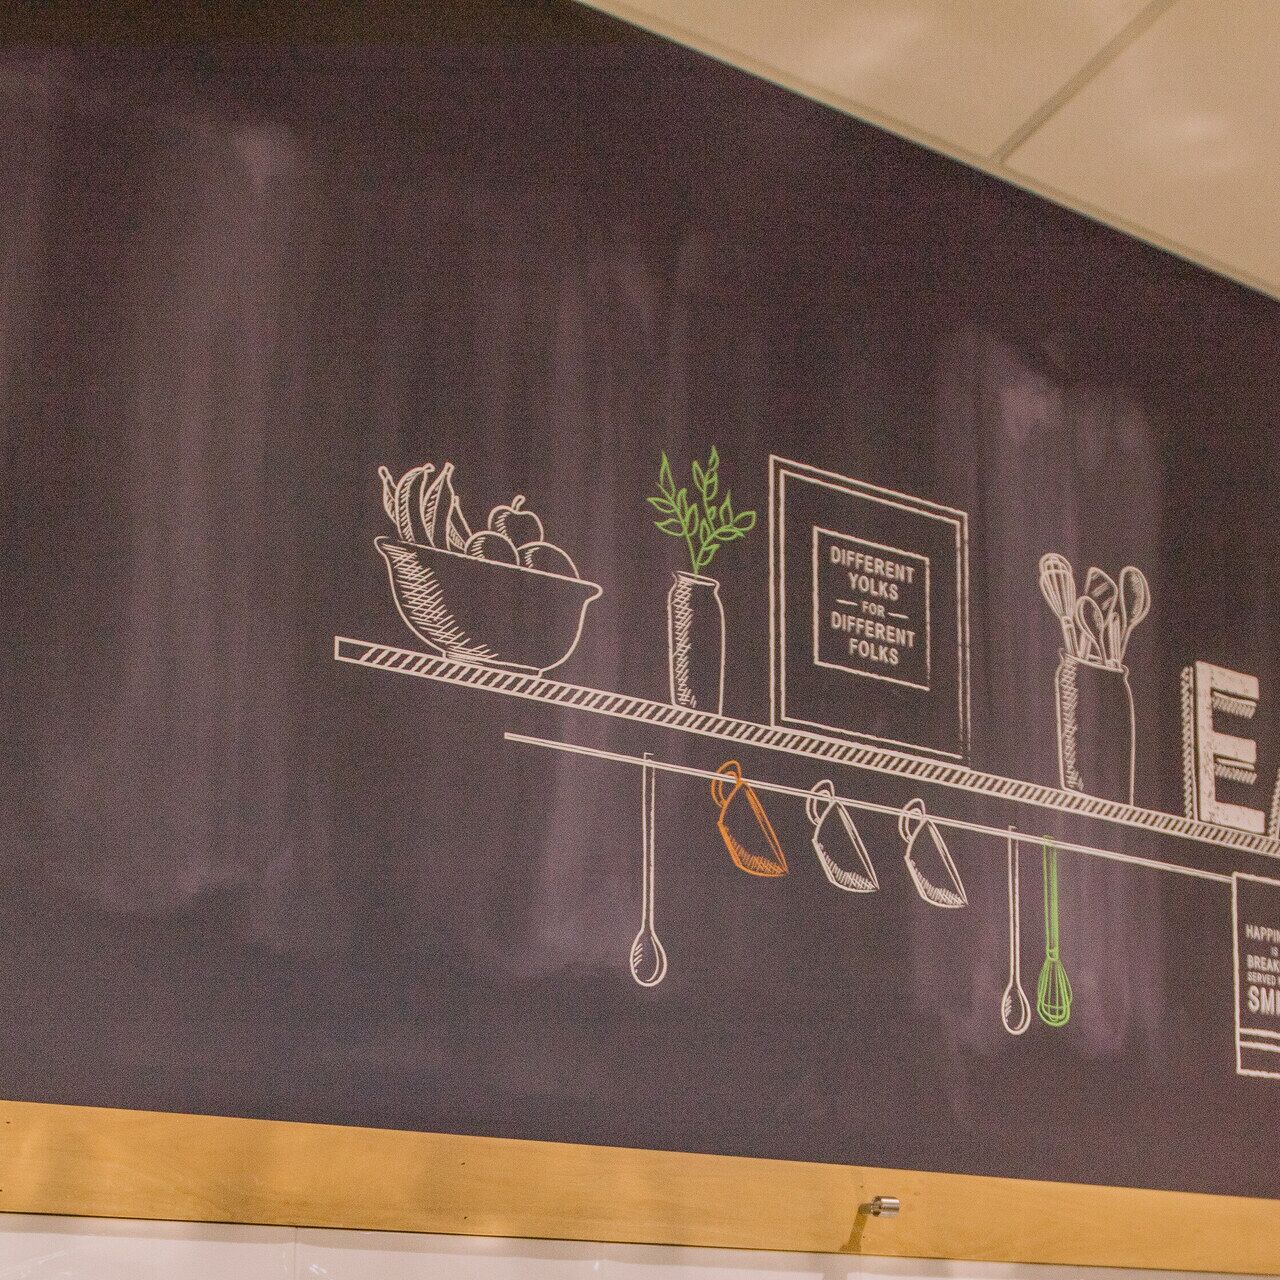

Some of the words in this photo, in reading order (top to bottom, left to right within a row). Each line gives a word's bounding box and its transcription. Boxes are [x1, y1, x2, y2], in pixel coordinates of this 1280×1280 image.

[831, 545, 915, 584] DIFFERENT
[848, 572, 898, 601] YOLKS
[862, 601, 885, 618] FOR
[831, 611, 915, 648] DIFFERENT
[849, 638, 898, 665] FOLKS
[1247, 971, 1276, 986] SERVED
